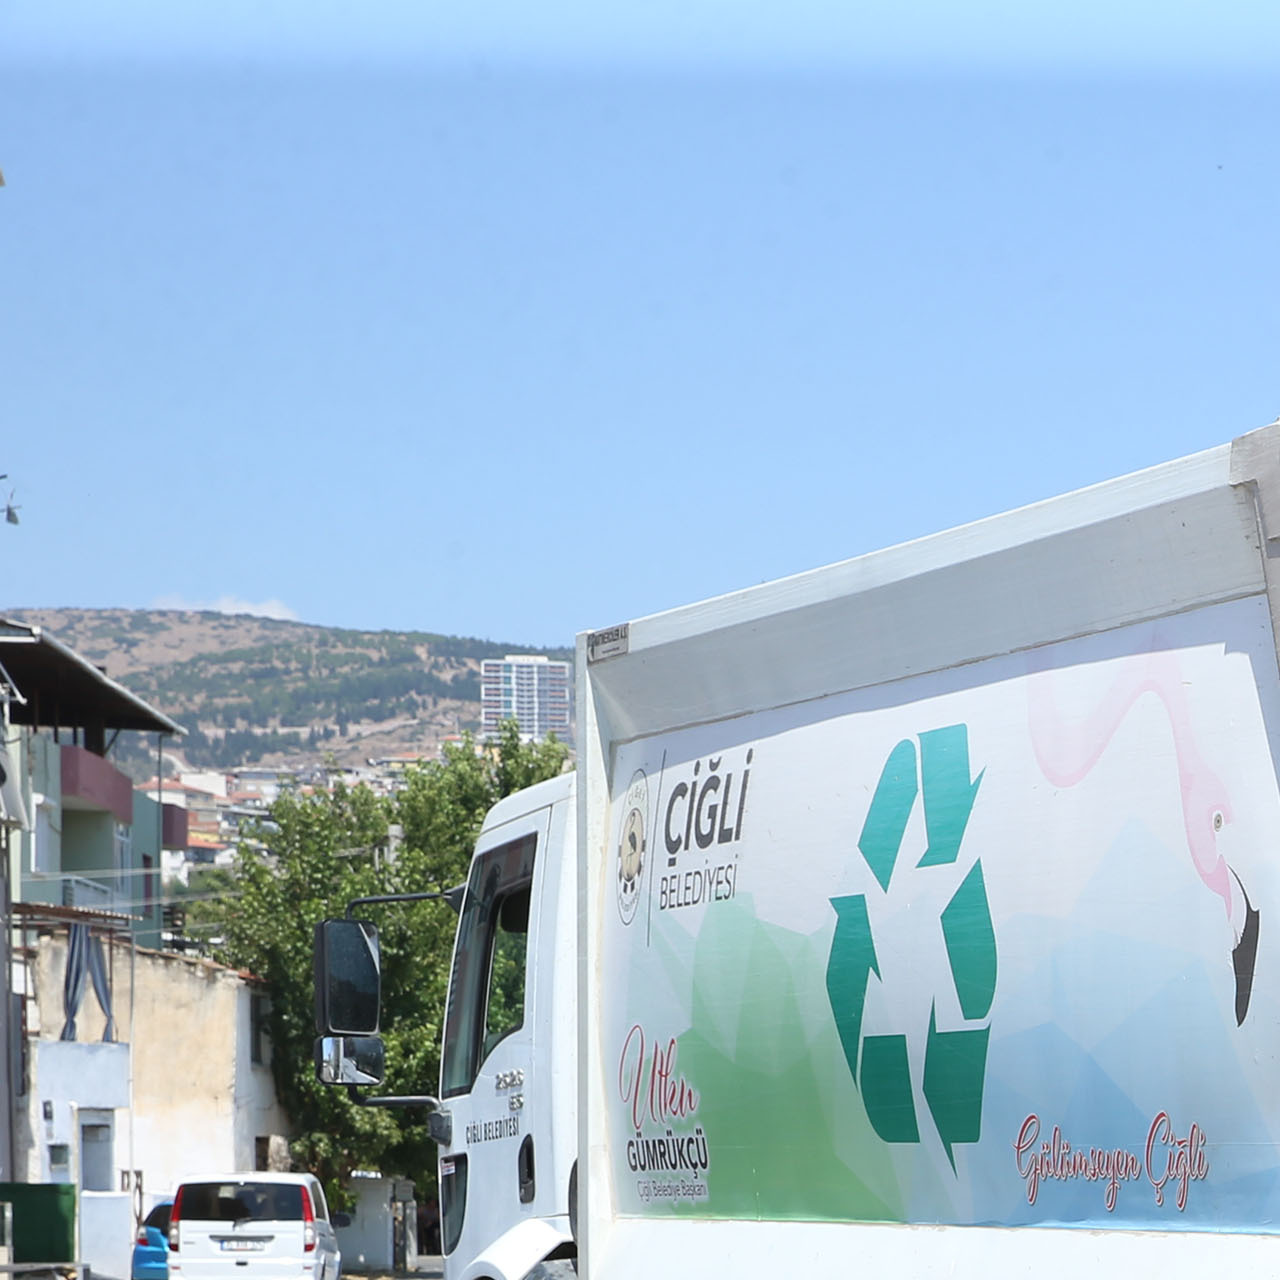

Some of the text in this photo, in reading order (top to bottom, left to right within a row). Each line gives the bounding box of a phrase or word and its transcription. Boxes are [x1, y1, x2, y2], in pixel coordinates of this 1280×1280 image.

[664, 748, 753, 867] ÇİĞLİ
[660, 853, 739, 910] BELEDİYESİ
[466, 1113, 519, 1148] ÇİĞLİ BELEDİYESİ
[627, 1128, 708, 1178] GÜMRÜKÇÜ
[1012, 1110, 1209, 1211] Gülümseyen Çiğli
